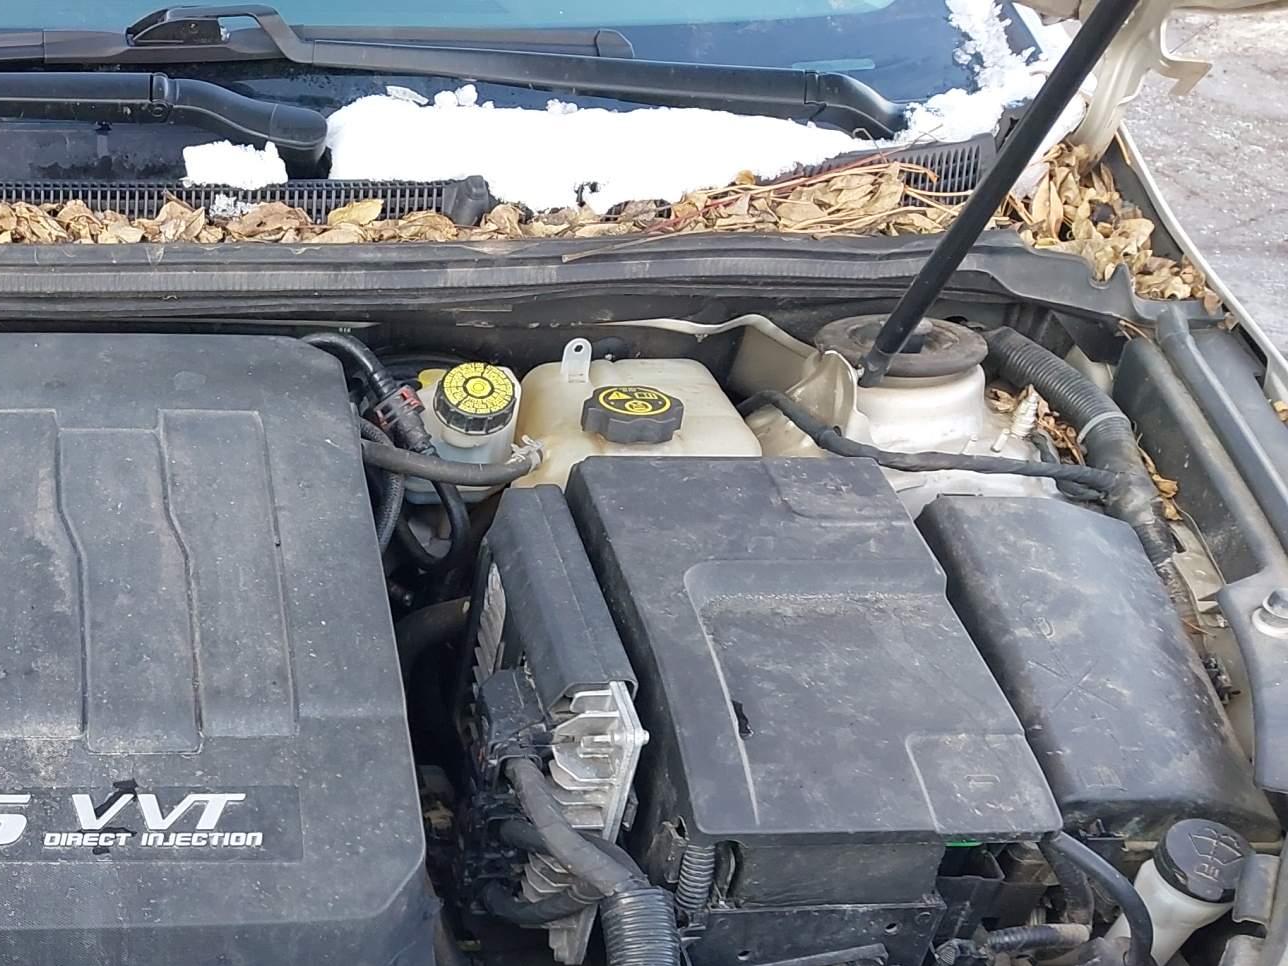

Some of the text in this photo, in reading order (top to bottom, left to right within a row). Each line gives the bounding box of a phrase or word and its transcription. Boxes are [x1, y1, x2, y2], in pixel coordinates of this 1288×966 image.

[71, 792, 247, 831] VVT
[44, 831, 264, 847] DIRECT INJECTION
